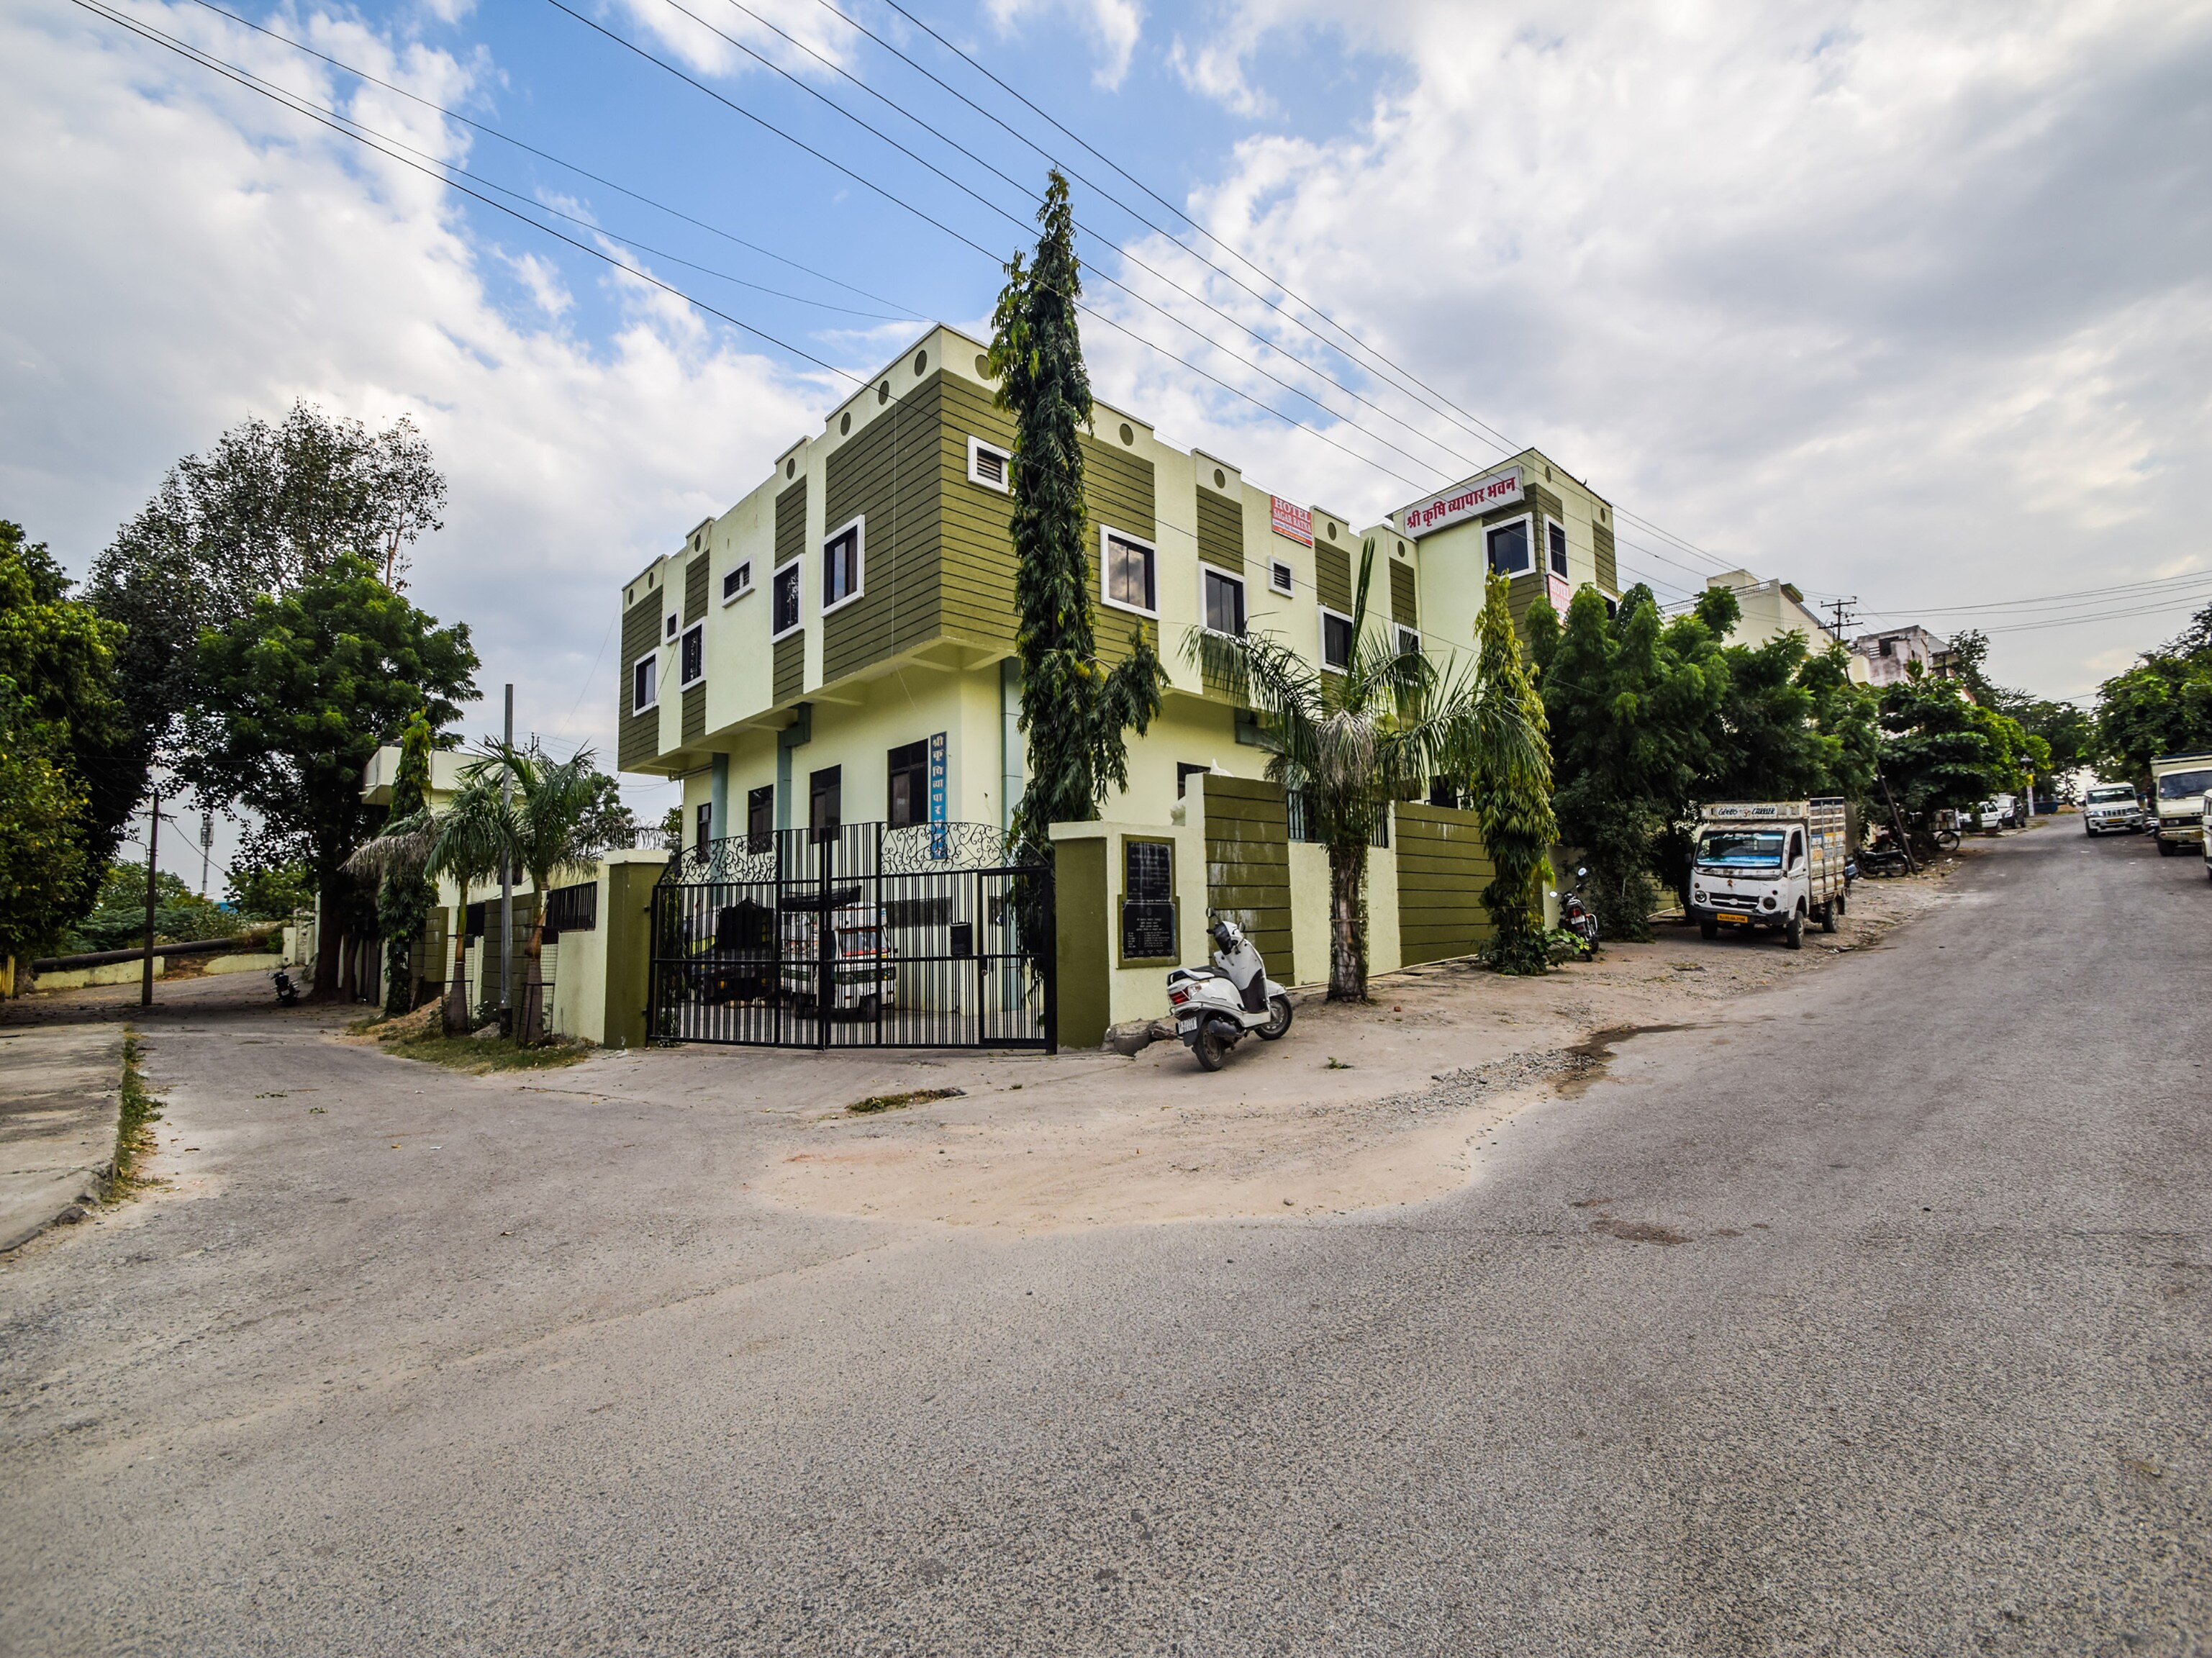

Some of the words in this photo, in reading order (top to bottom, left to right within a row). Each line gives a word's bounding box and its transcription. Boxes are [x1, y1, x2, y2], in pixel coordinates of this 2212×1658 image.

[1274, 497, 1310, 523] HOTEL
[1407, 507, 1421, 529] श्री
[1423, 500, 1446, 526] कृषि
[1448, 488, 1485, 512] व्यापार
[1487, 476, 1516, 498] भवन
[1273, 508, 1293, 525] SAGAR
[1292, 517, 1312, 533] RATNA
